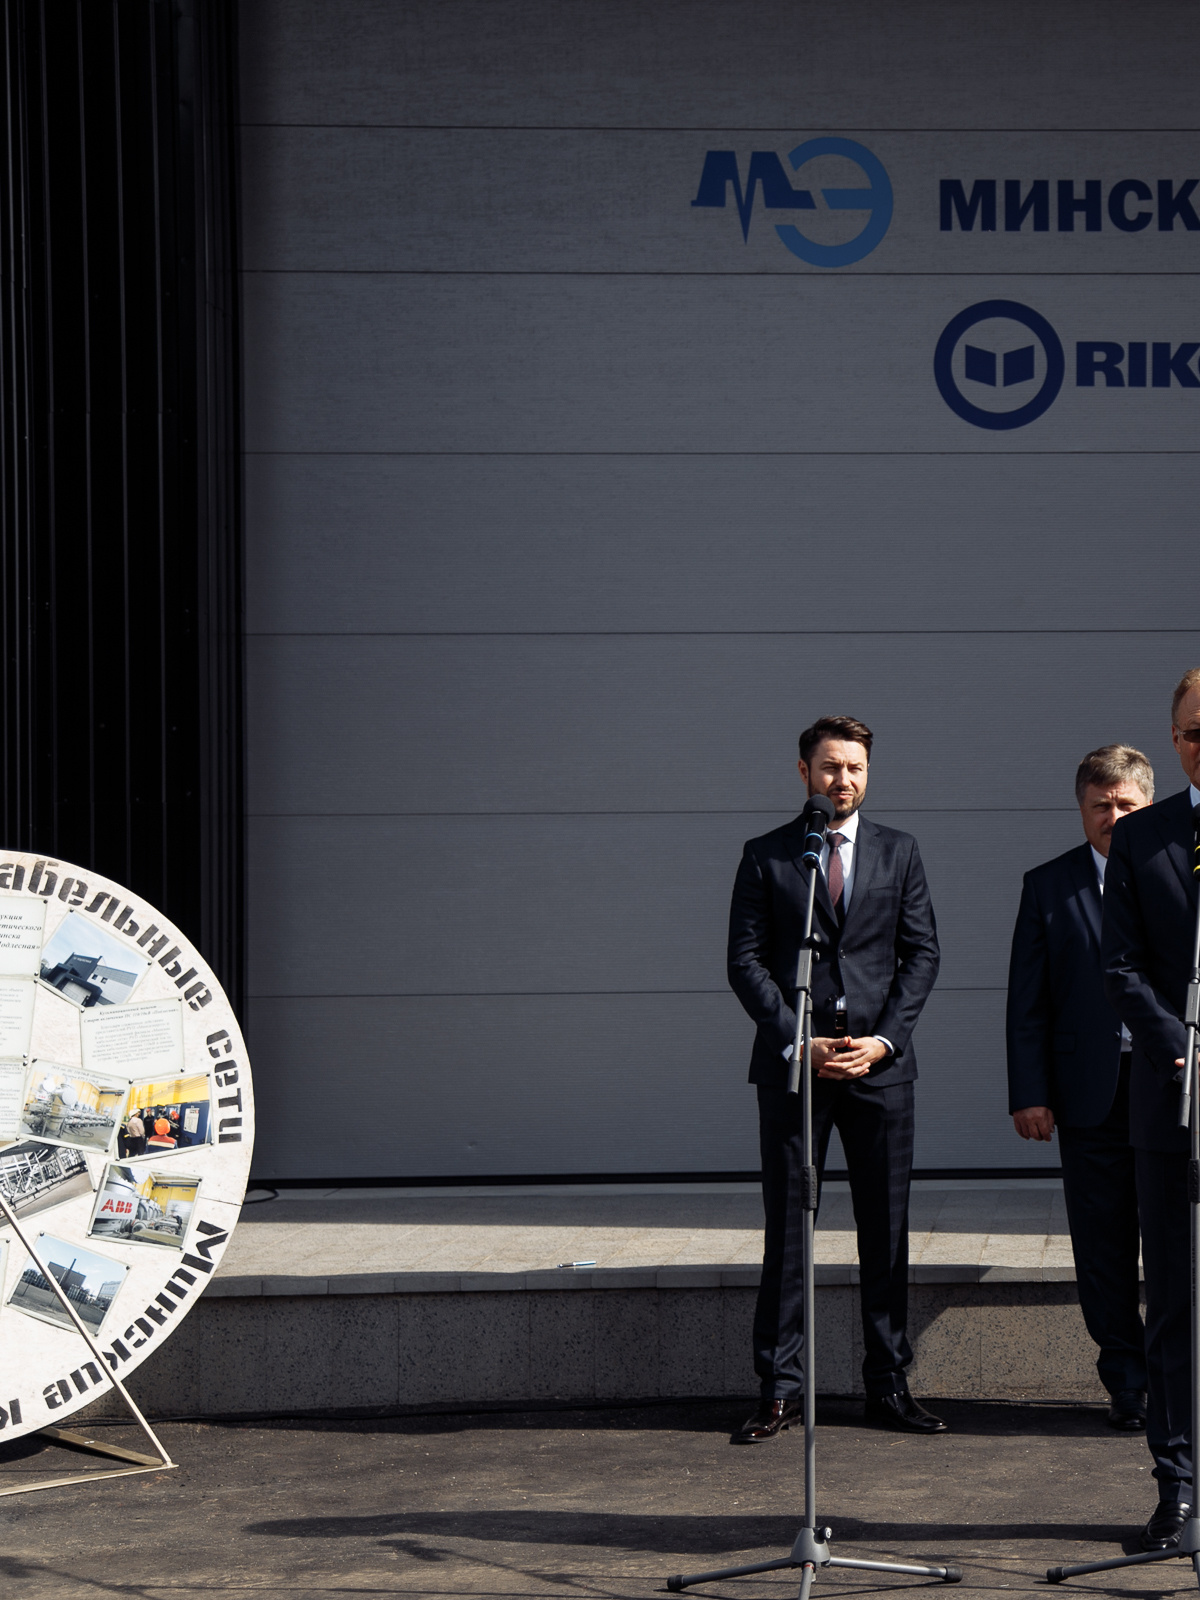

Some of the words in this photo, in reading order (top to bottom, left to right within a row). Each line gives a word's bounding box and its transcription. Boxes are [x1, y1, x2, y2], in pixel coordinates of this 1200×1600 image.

[206, 1029, 243, 1144] сети
[100, 1198, 133, 1214] ABB
[42, 1220, 229, 1410] Минские
